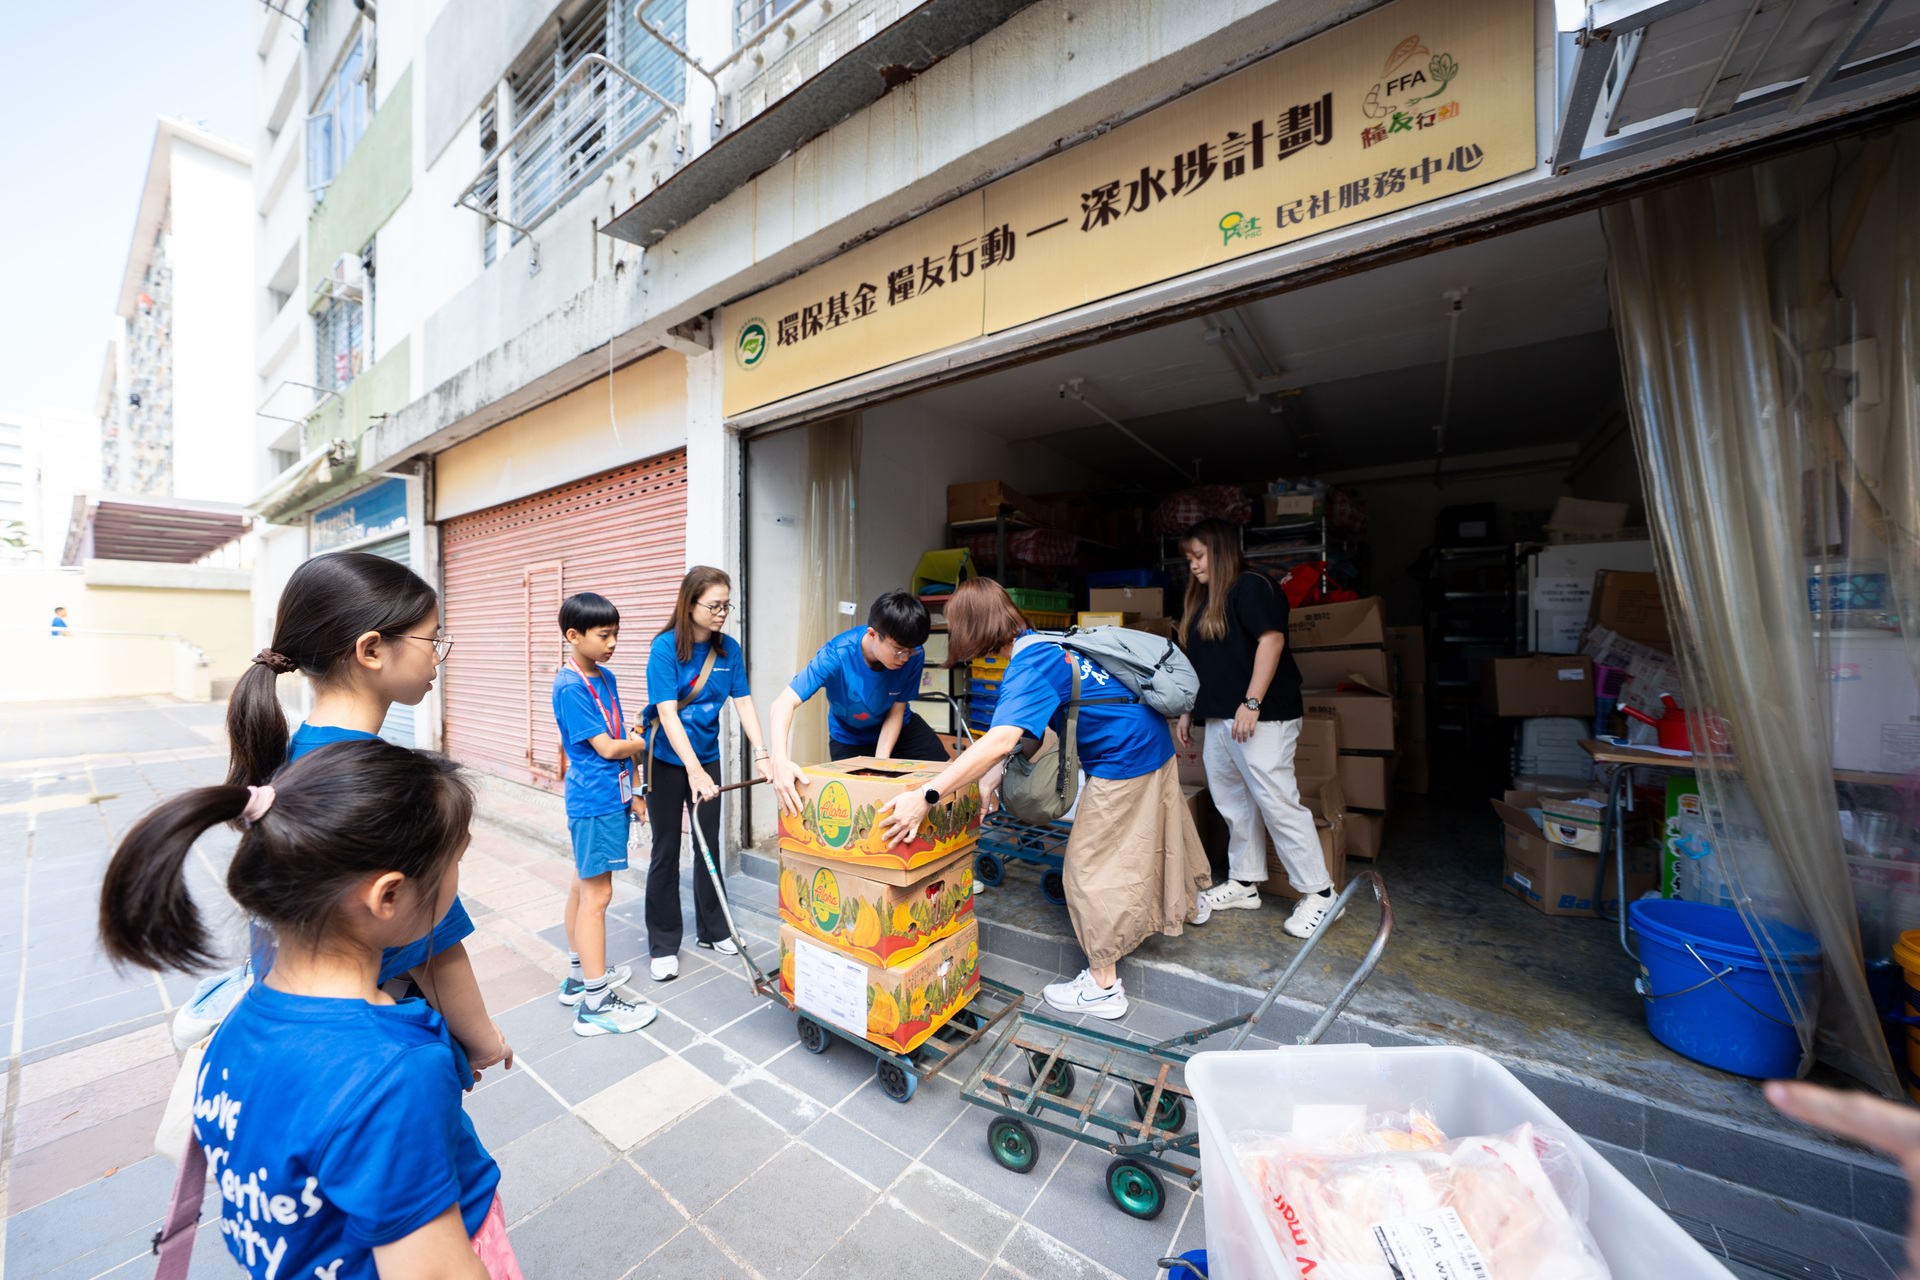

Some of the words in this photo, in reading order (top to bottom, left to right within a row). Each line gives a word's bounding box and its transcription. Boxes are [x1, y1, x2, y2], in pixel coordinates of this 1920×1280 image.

[1387, 70, 1426, 96] FFA
[1276, 143, 1484, 230] 民社服務中心
[777, 282, 878, 347] 環保基金
[887, 223, 1015, 307] 糧友行動
[1080, 92, 1332, 233] 深水埗計劃
[1245, 230, 1262, 240] PSC
[820, 801, 849, 818] Aloha
[814, 885, 838, 906] Aloha
[1505, 874, 1543, 902] Baxter
